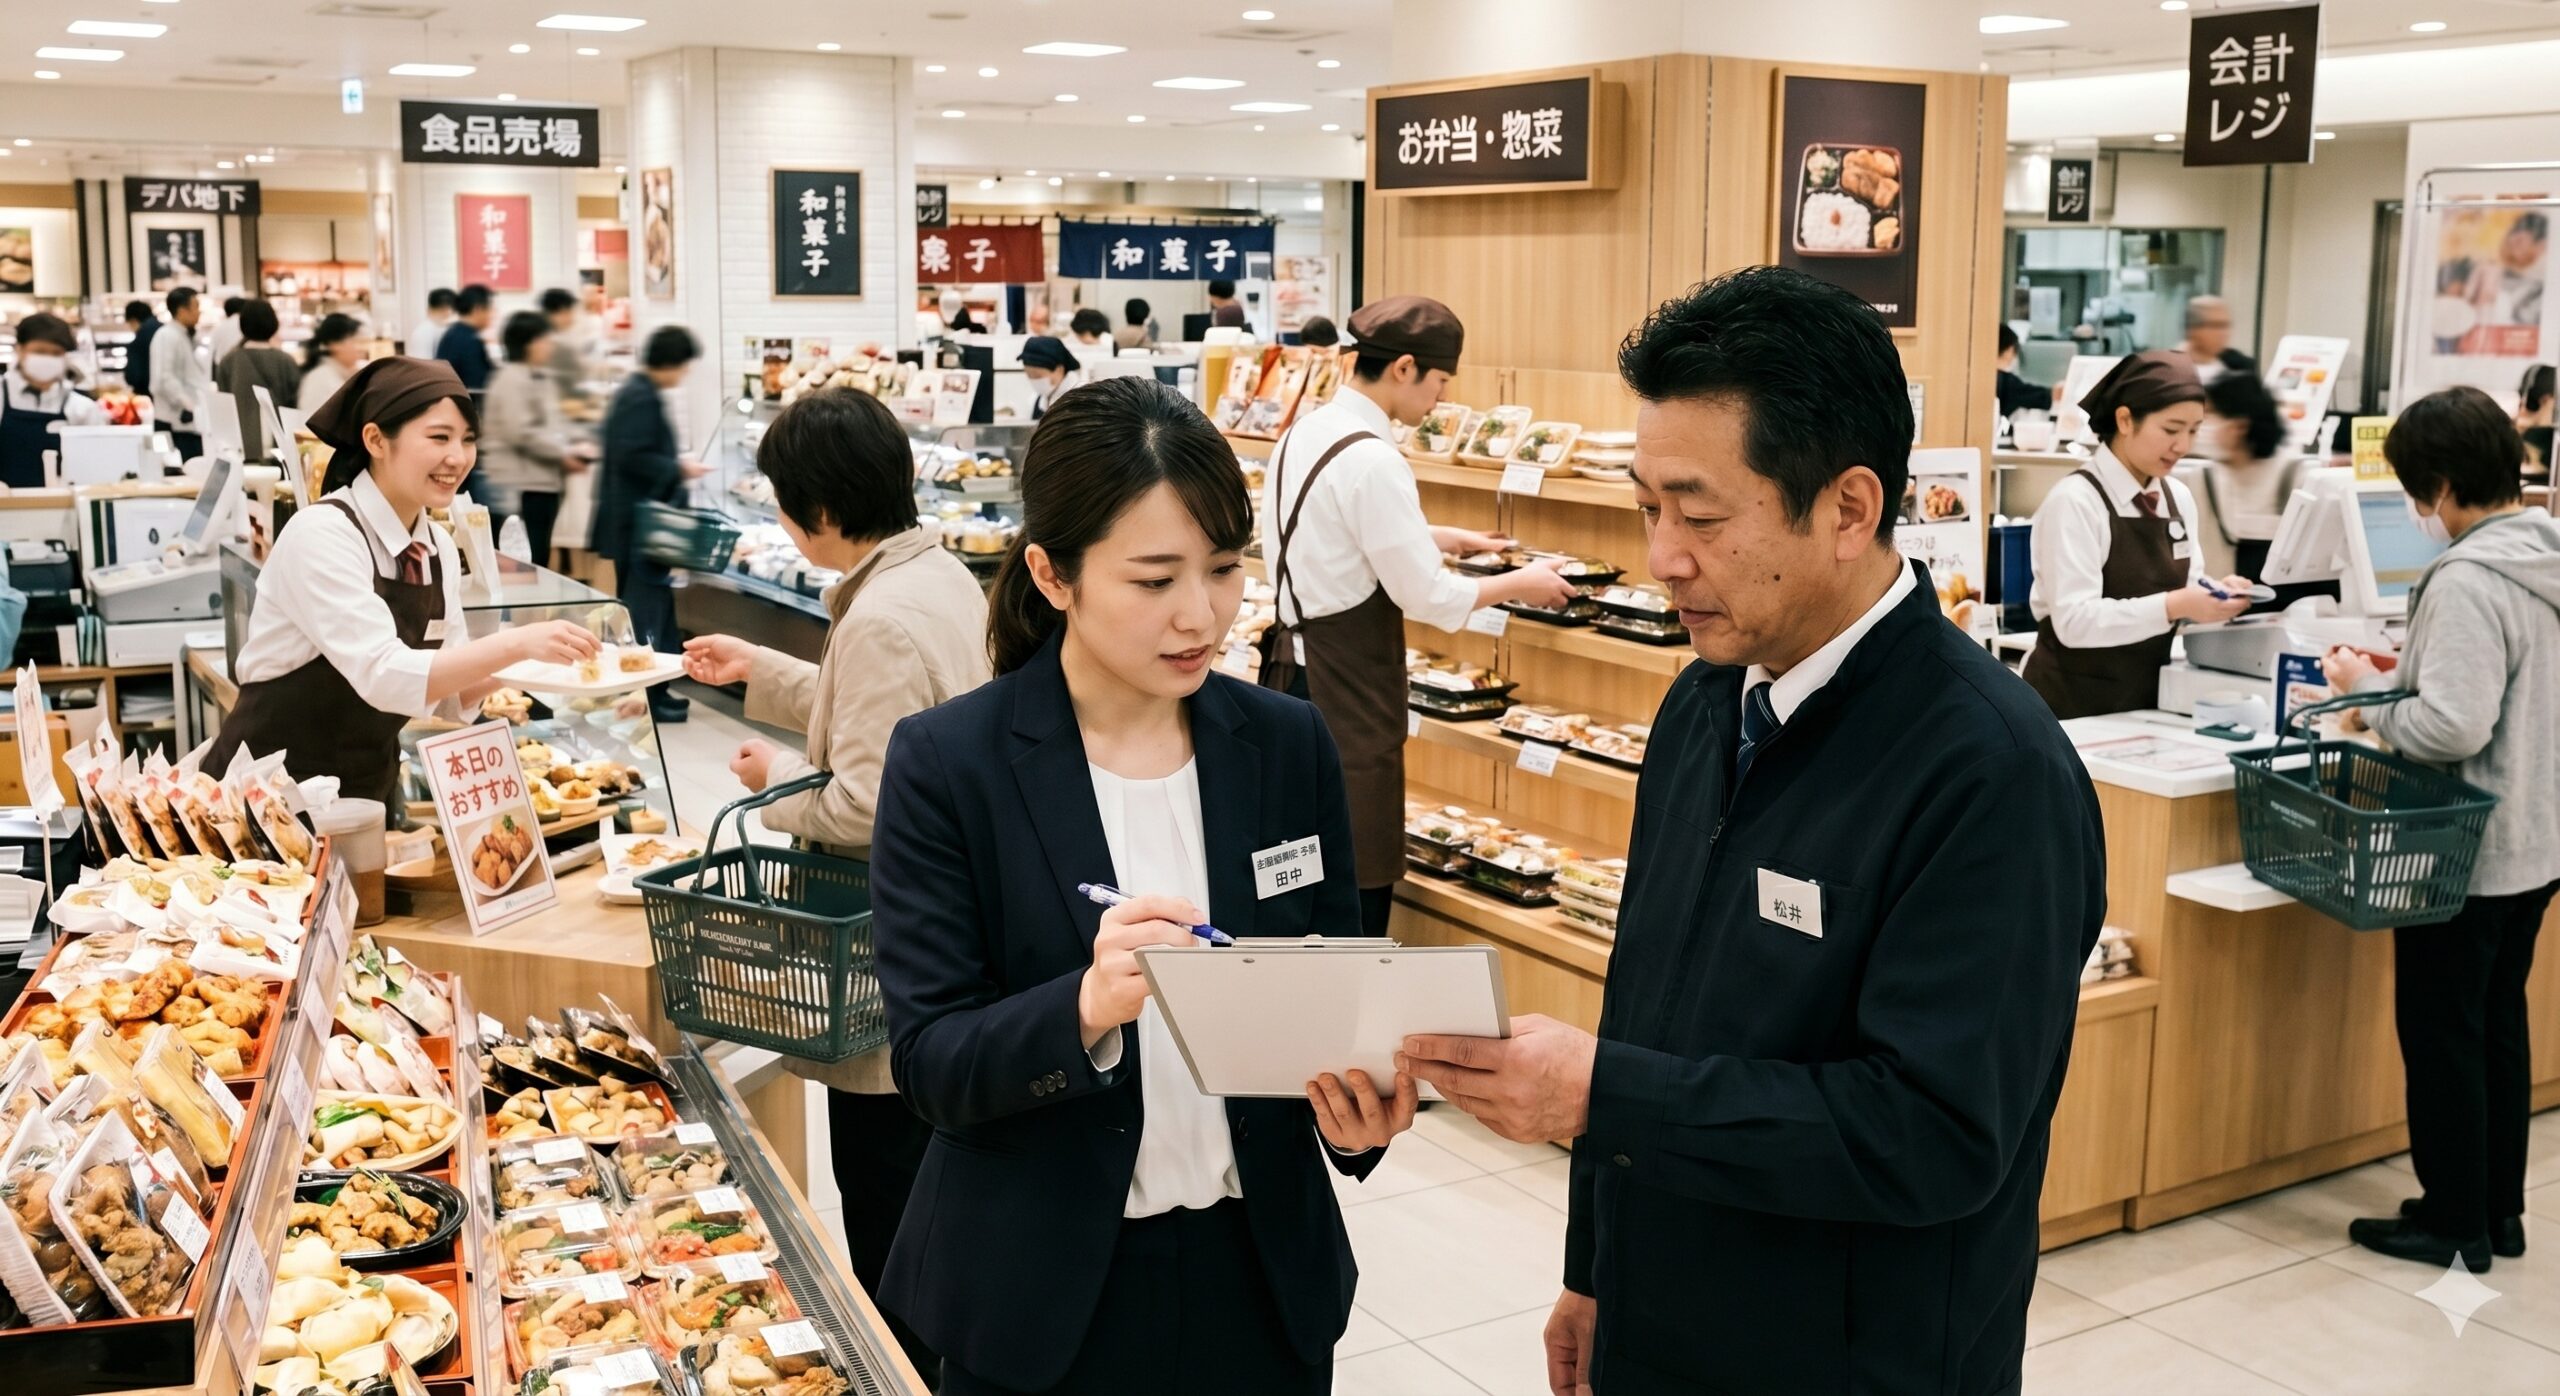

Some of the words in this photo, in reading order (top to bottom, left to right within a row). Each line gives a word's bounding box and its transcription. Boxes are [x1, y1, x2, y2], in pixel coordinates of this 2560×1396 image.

[2209, 32, 2295, 86] 会計
[420, 113, 582, 157] 食品売場
[1398, 107, 1563, 165] お弁当・惣菜
[2210, 91, 2291, 142] レジ
[480, 203, 508, 281] 和菓子
[799, 188, 829, 277] 和菓子
[1111, 237, 1237, 273] 和菓子
[445, 746, 503, 780] 本日の
[449, 774, 519, 817] おすすめ
[1275, 867, 1302, 887] 田中
[1773, 898, 1802, 924] 松井
